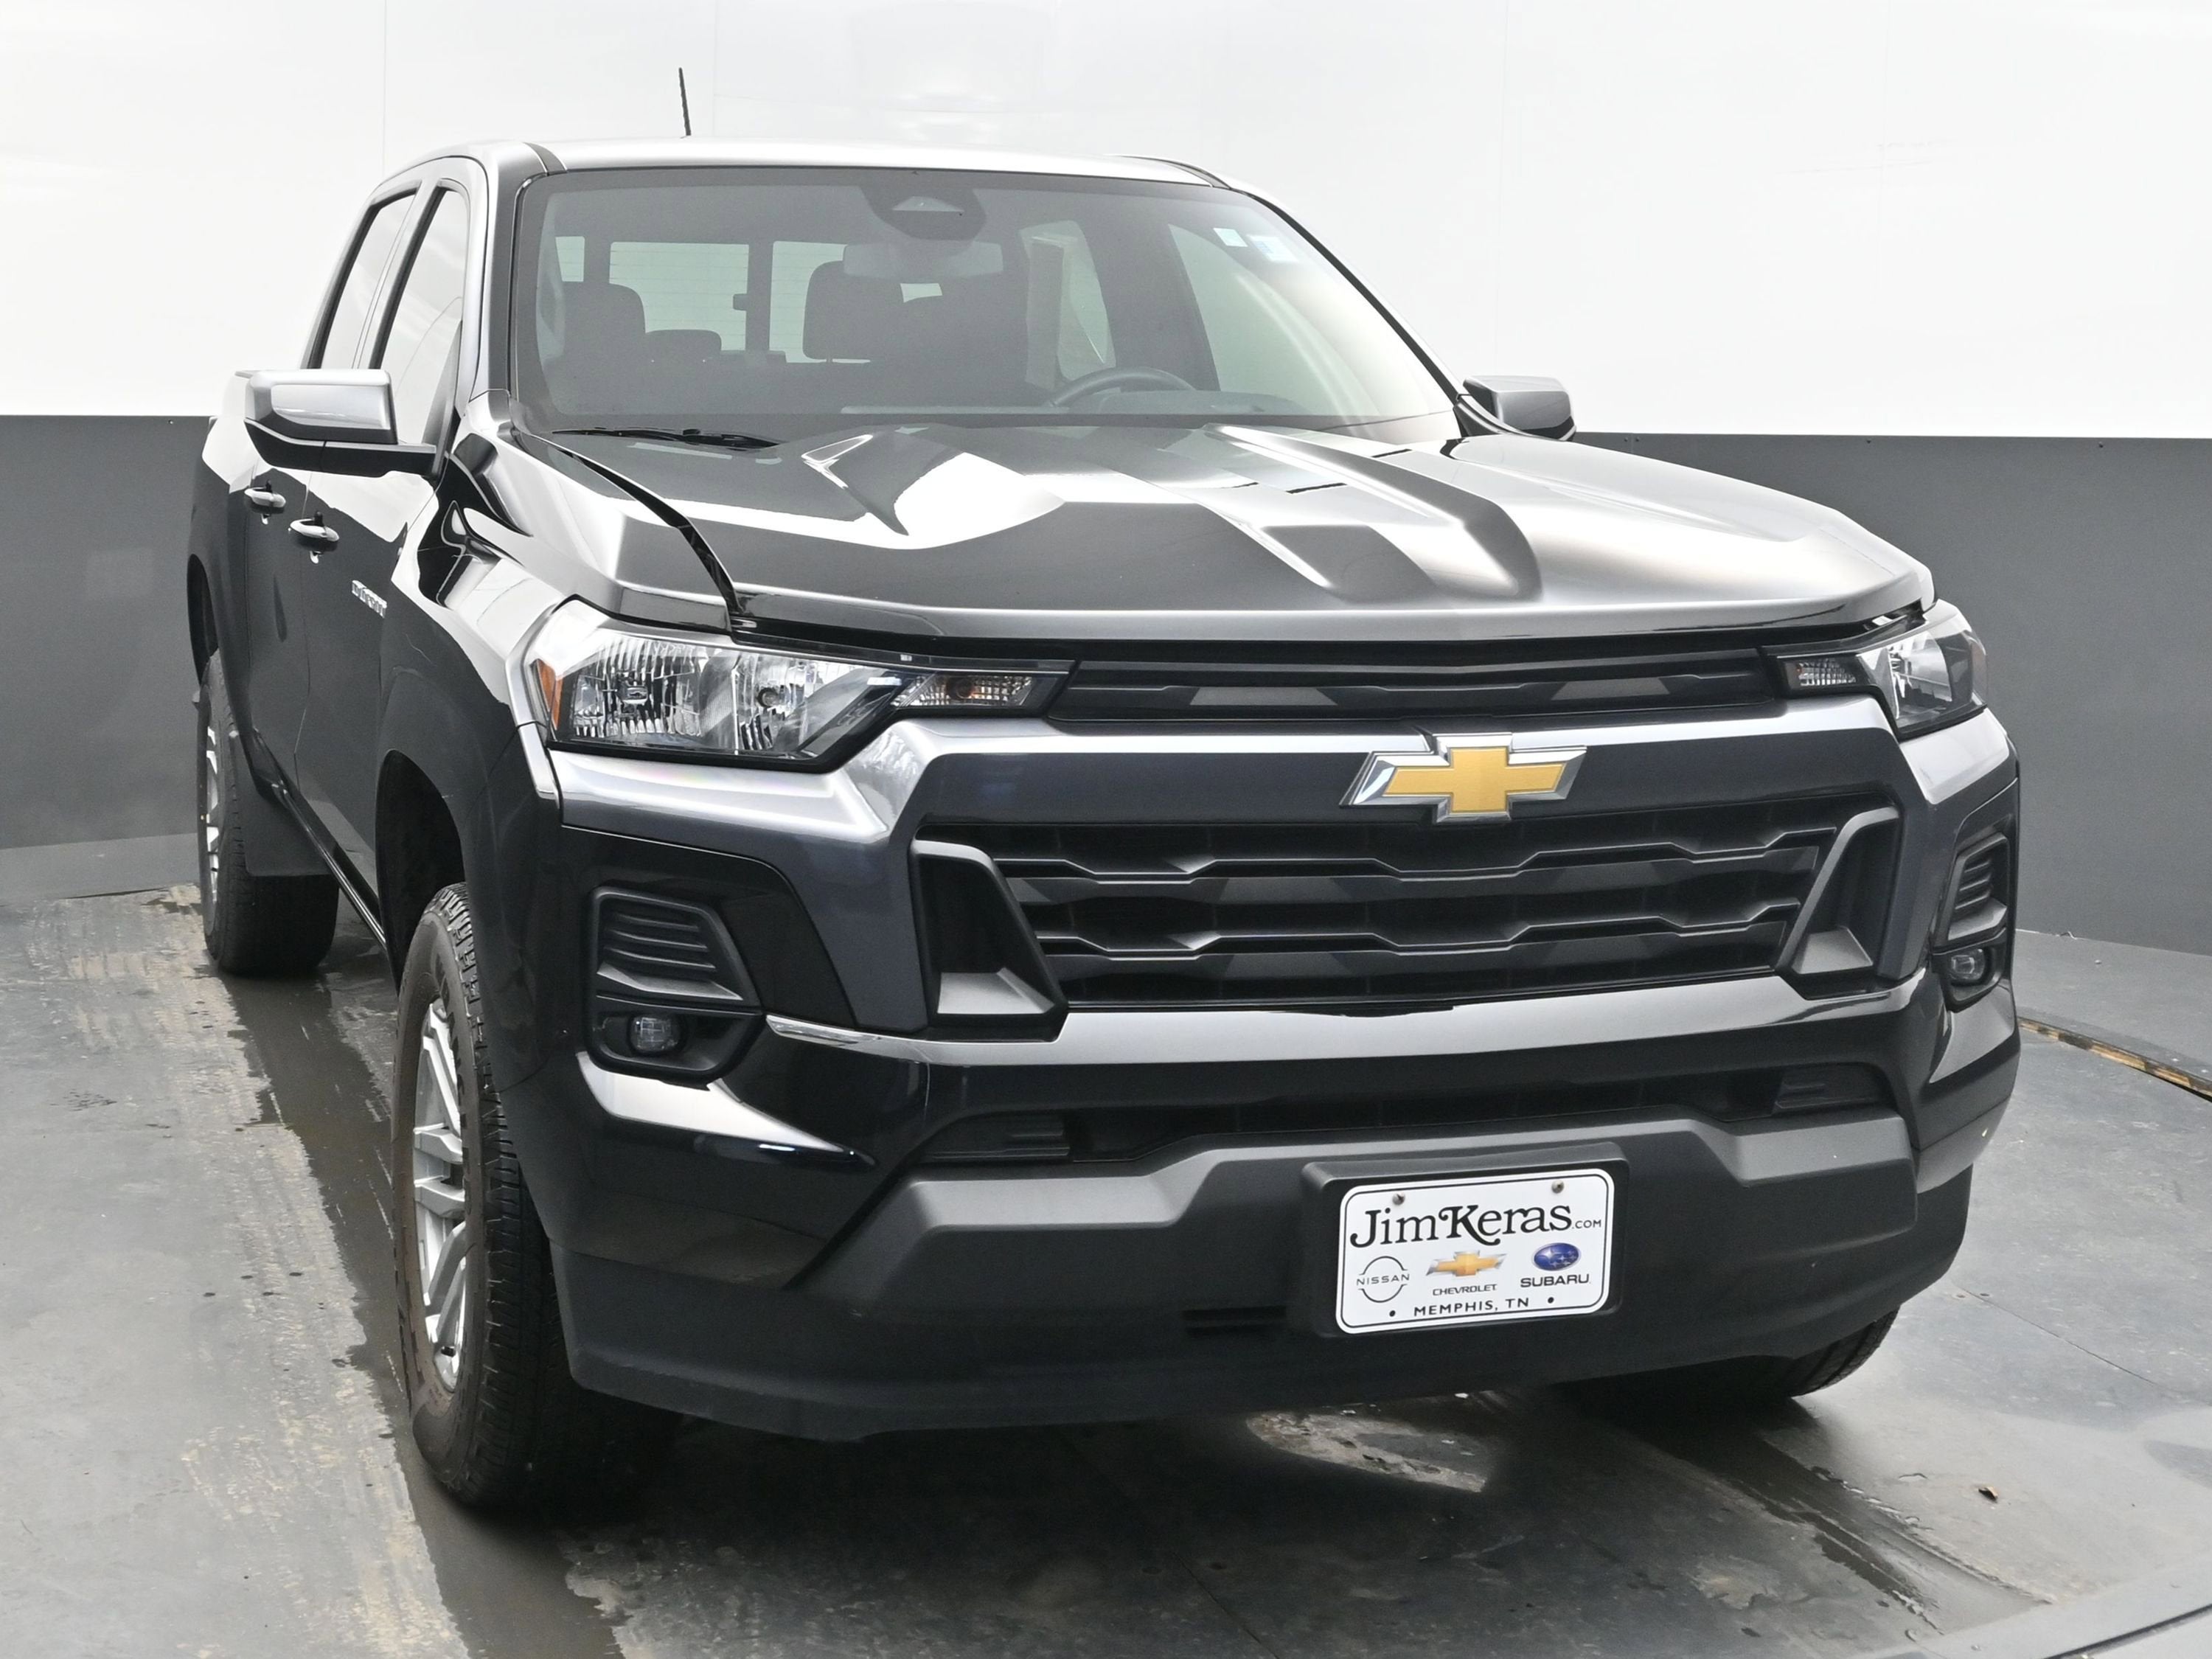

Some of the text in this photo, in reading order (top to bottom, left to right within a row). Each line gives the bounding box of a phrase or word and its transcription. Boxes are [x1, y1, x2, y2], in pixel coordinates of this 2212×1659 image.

[1357, 1273, 1410, 1285] NISSAN
[1520, 1273, 1590, 1287] SUBARU
[1433, 1284, 1497, 1296] CHEVROLET
[1413, 1297, 1529, 1317] MEMPHIS, TN
